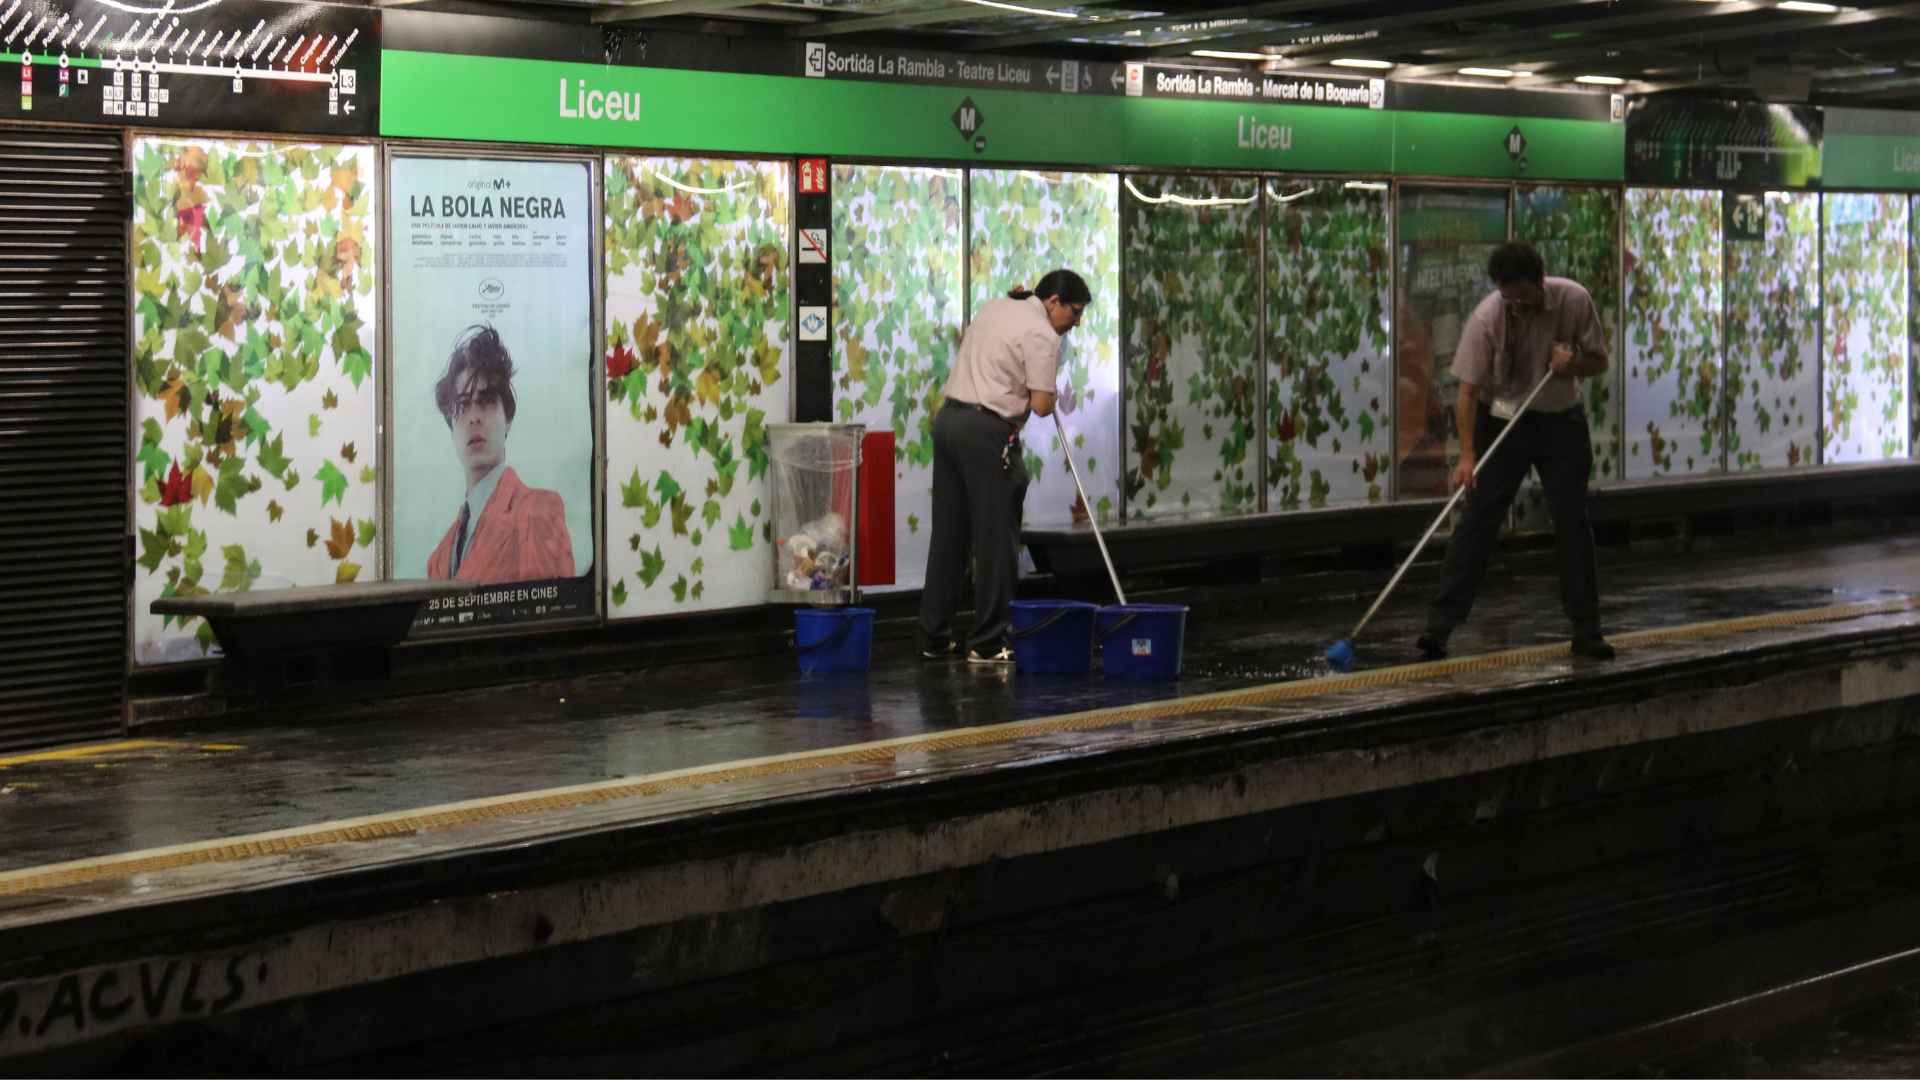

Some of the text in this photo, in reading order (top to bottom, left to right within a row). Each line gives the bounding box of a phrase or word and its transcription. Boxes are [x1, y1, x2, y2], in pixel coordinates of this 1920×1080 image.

[827, 51, 875, 73] Sortida
[878, 55, 895, 76] La
[897, 57, 946, 78] Rambla
[957, 60, 995, 81] Teatre
[997, 62, 1030, 83] Liceu
[341, 74, 354, 89] L3
[1156, 72, 1196, 94] Sortida
[1198, 76, 1212, 96] La
[1214, 77, 1253, 97] Rambla
[1263, 79, 1298, 100] Mercat
[1300, 82, 1313, 101] de
[1315, 83, 1325, 101] la
[559, 79, 641, 121] Liceu
[960, 108, 976, 132] M
[1237, 115, 1293, 150] Liceu
[410, 195, 566, 219] LA BOLA NEGRA
[442, 596, 456, 609] DE
[457, 591, 516, 607] SEPTIEMBRE
[517, 588, 529, 602] EN
[531, 586, 559, 601] CINES
